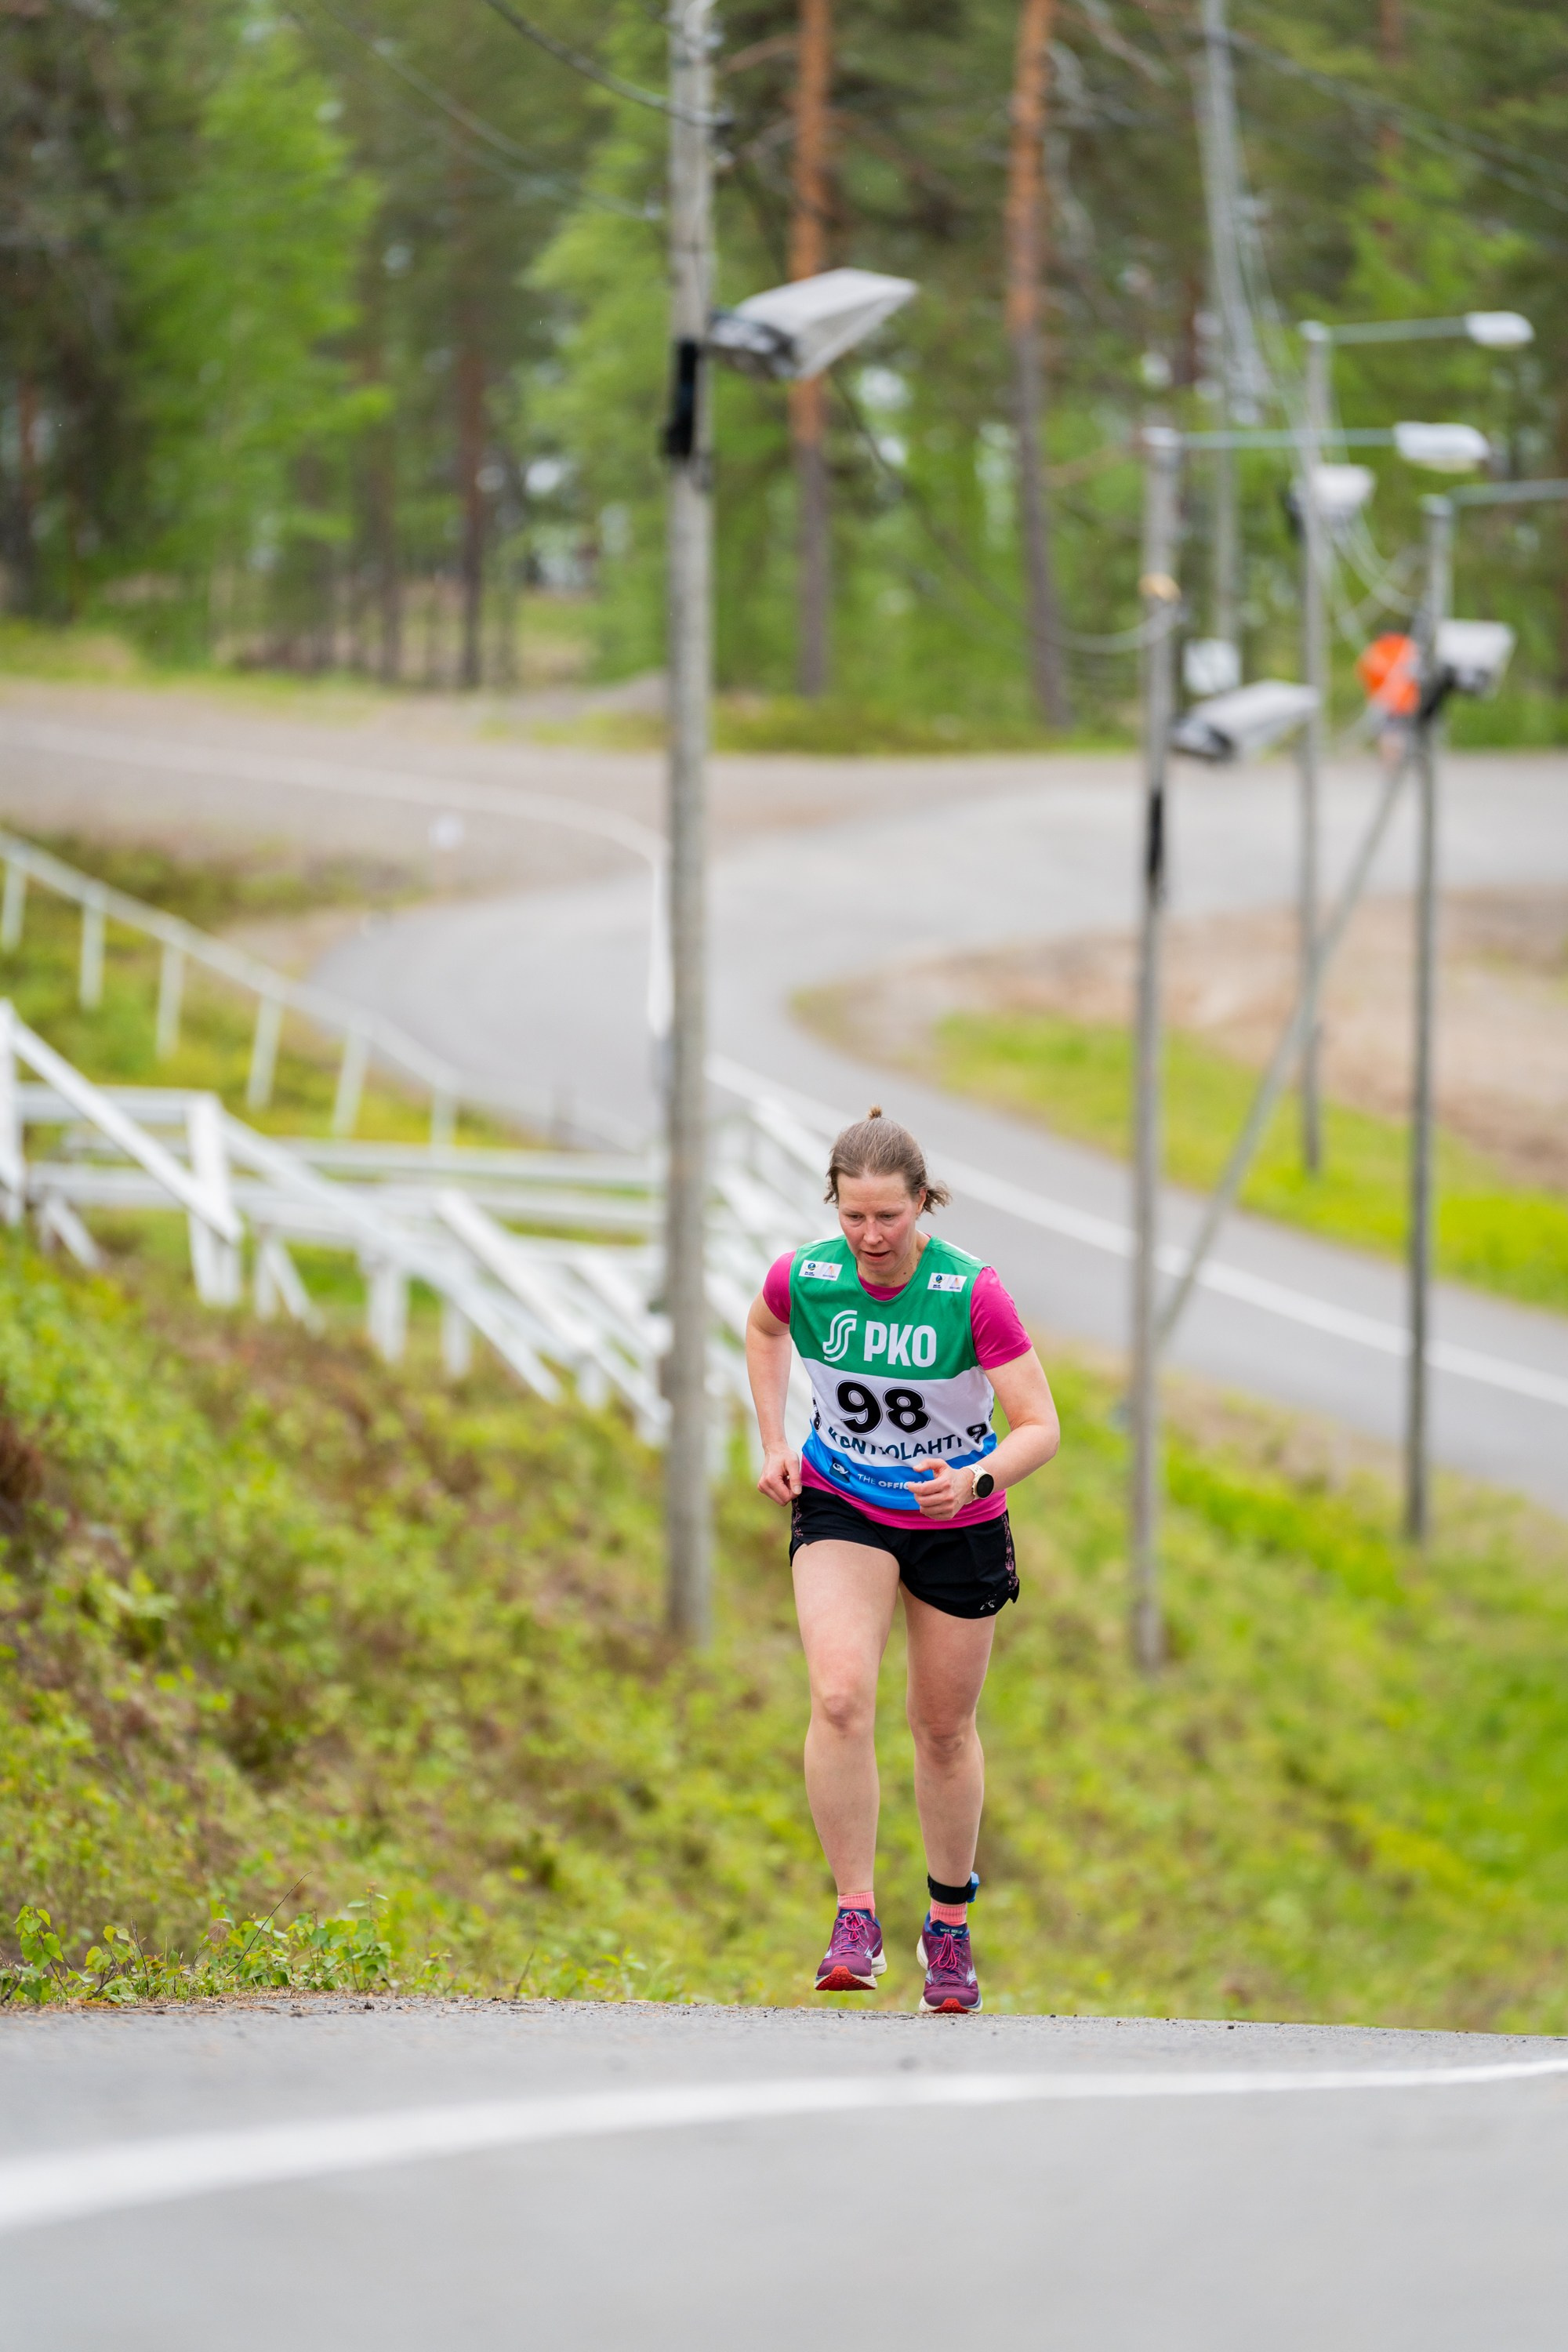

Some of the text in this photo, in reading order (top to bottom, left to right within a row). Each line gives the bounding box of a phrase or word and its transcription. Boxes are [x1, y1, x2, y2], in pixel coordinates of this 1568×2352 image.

[864, 1320, 937, 1367] PKO
[836, 1380, 931, 1435] 98
[858, 1474, 877, 1485] THE
